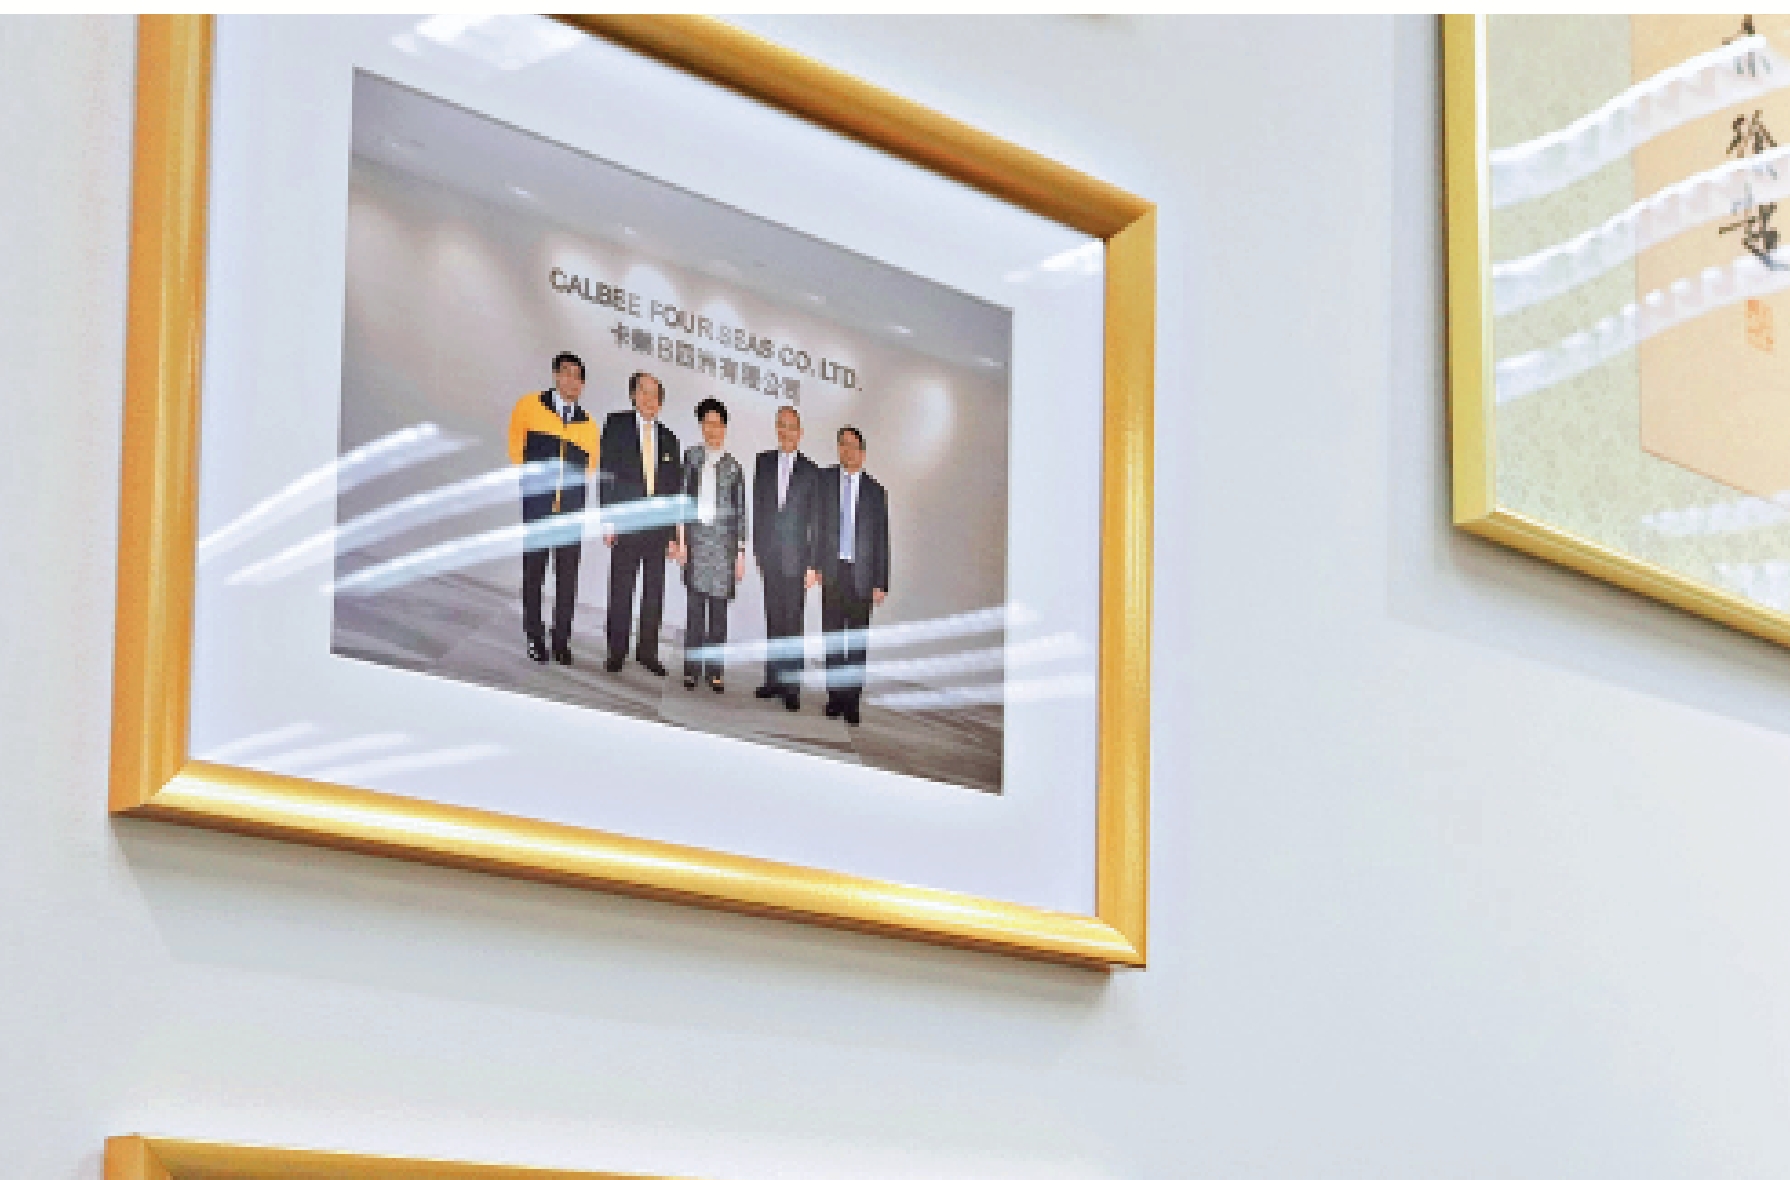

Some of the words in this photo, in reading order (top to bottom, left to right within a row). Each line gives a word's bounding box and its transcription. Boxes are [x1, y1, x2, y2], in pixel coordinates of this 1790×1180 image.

[549, 266, 643, 319] CALBEE
[651, 300, 714, 340] FOUR
[716, 325, 773, 359] SEAS
[777, 347, 816, 378] CO.
[821, 357, 863, 392] LTD.
